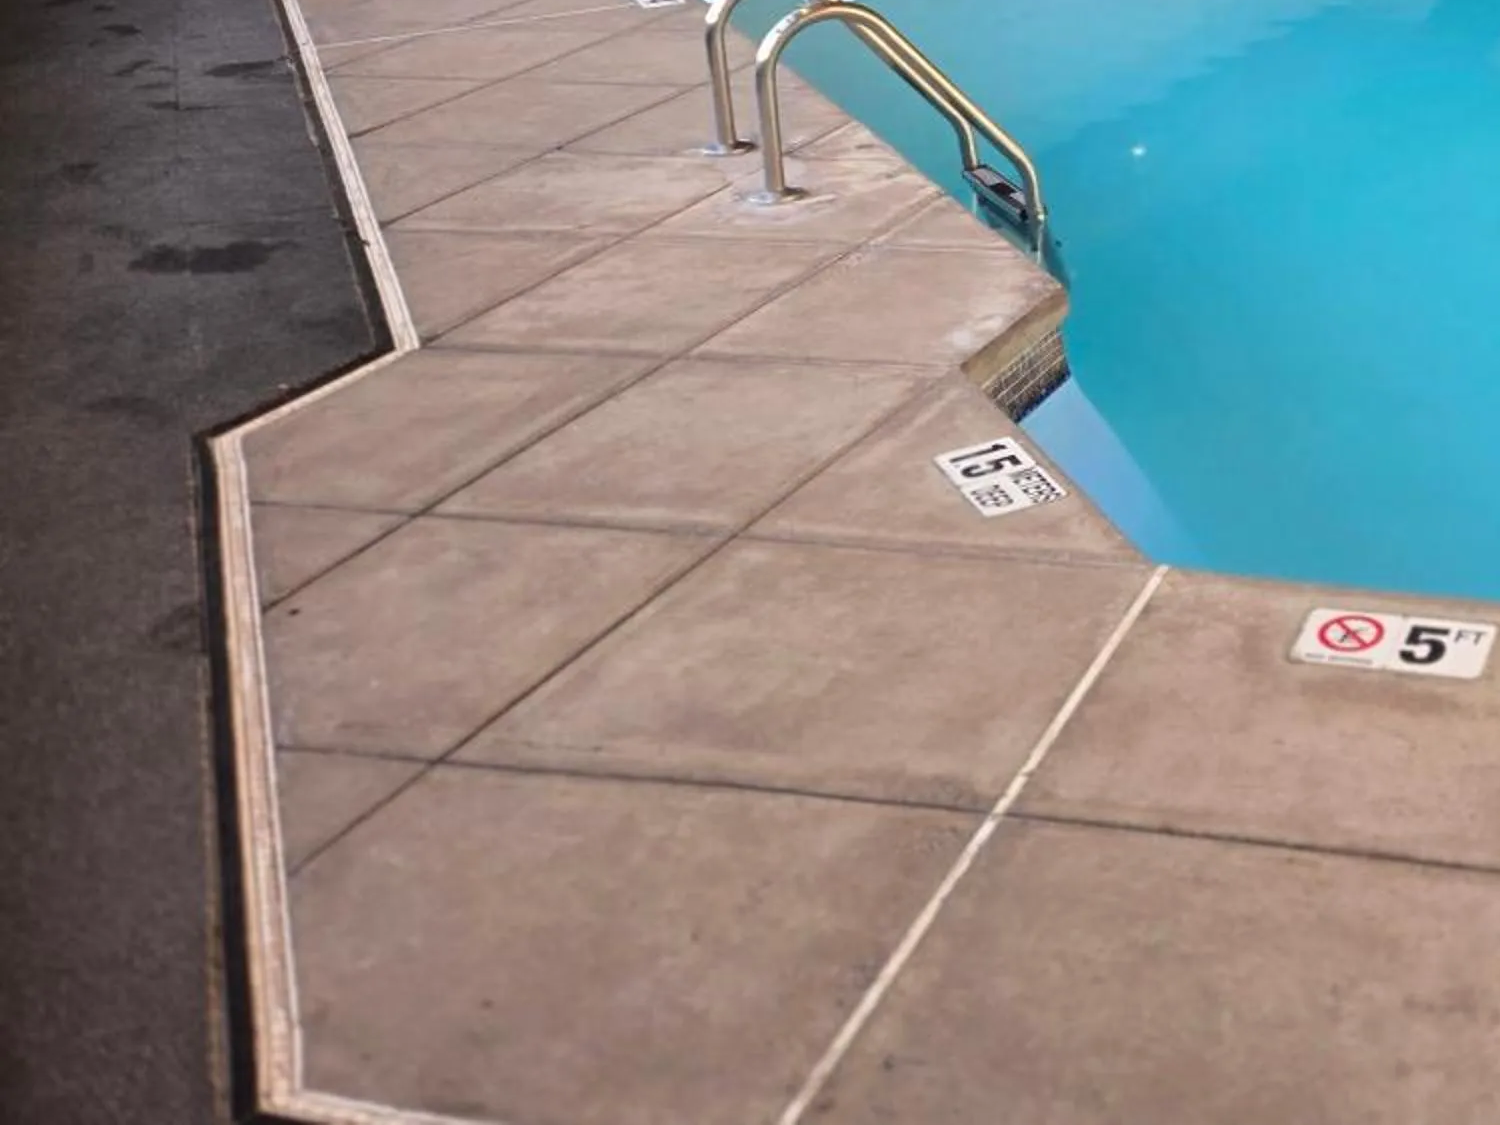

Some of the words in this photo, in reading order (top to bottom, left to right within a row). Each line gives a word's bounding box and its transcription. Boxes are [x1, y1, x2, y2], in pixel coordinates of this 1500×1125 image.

[1007, 466, 1061, 504] METERS
[1398, 624, 1452, 666] 5
[1453, 628, 1489, 646] FT
